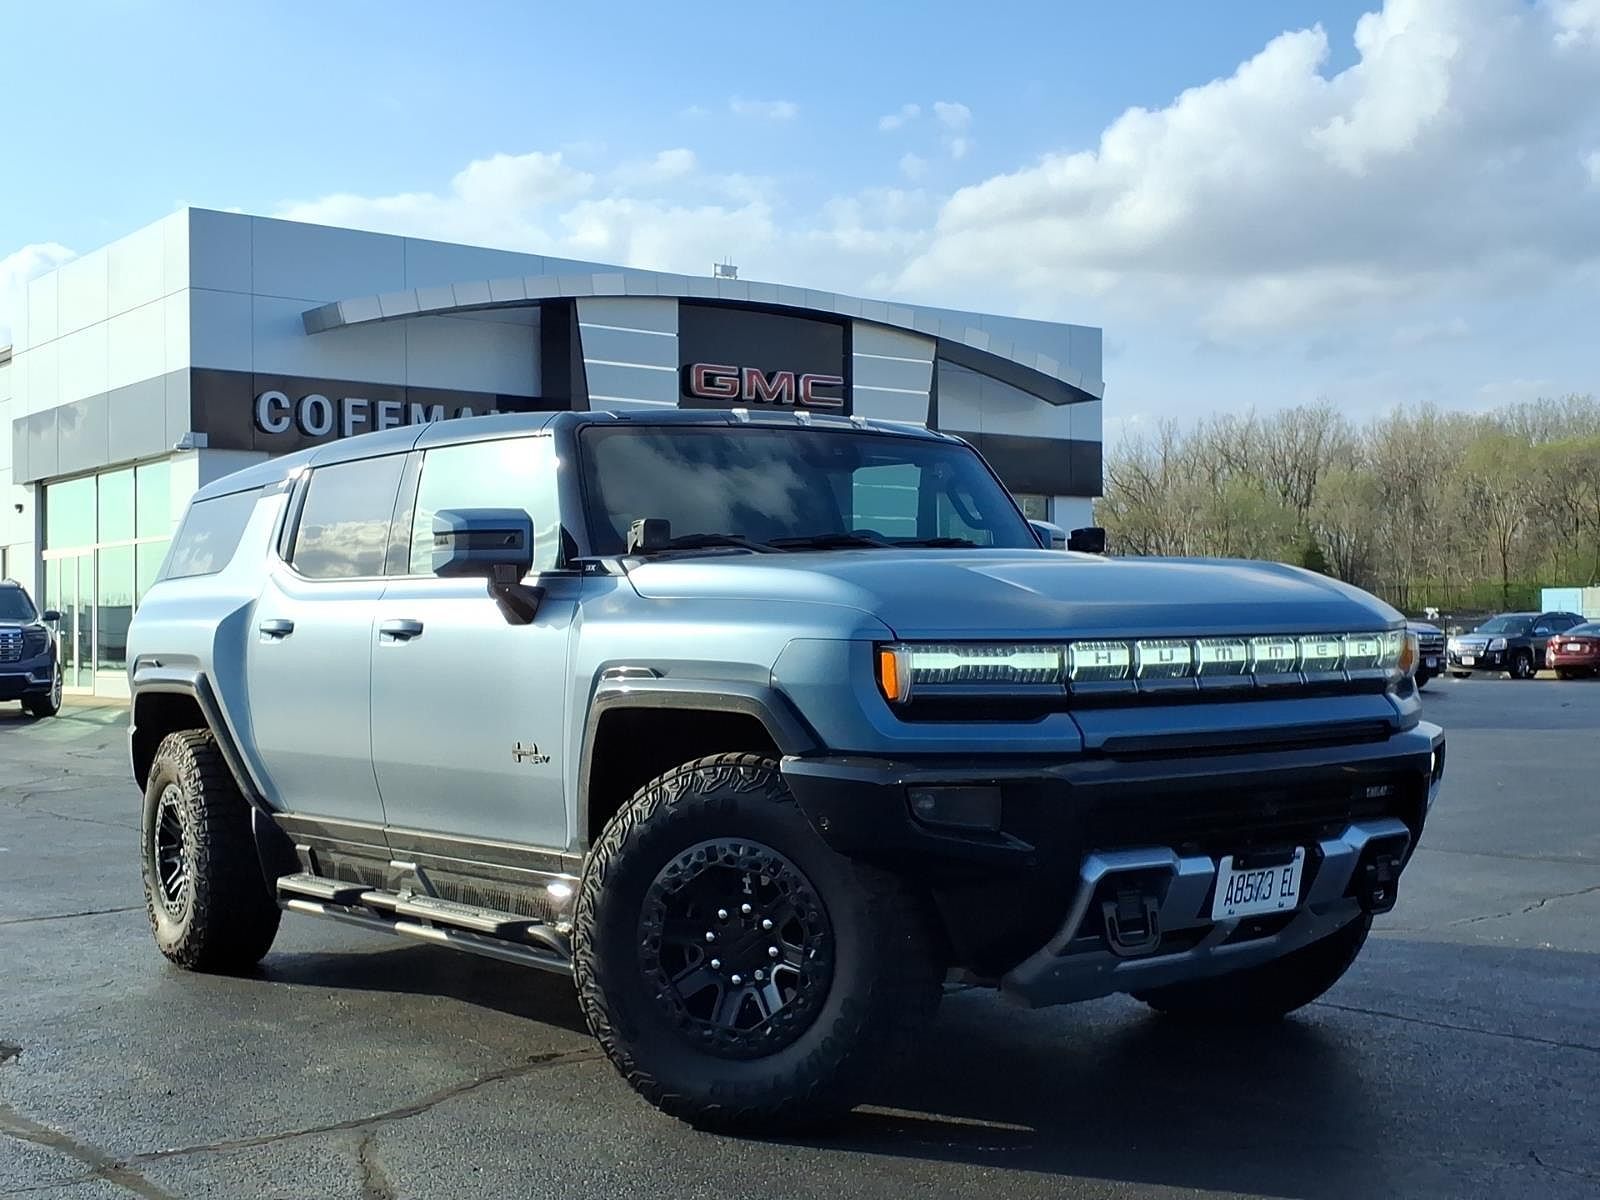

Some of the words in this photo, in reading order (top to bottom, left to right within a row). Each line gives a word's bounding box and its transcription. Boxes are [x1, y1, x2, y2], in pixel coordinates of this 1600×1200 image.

[692, 363, 844, 406] GMC
[255, 390, 516, 438] COFFM
[1095, 643, 1369, 664] HUMMER
[1224, 870, 1274, 906] A8573
[1280, 867, 1296, 897] EL
